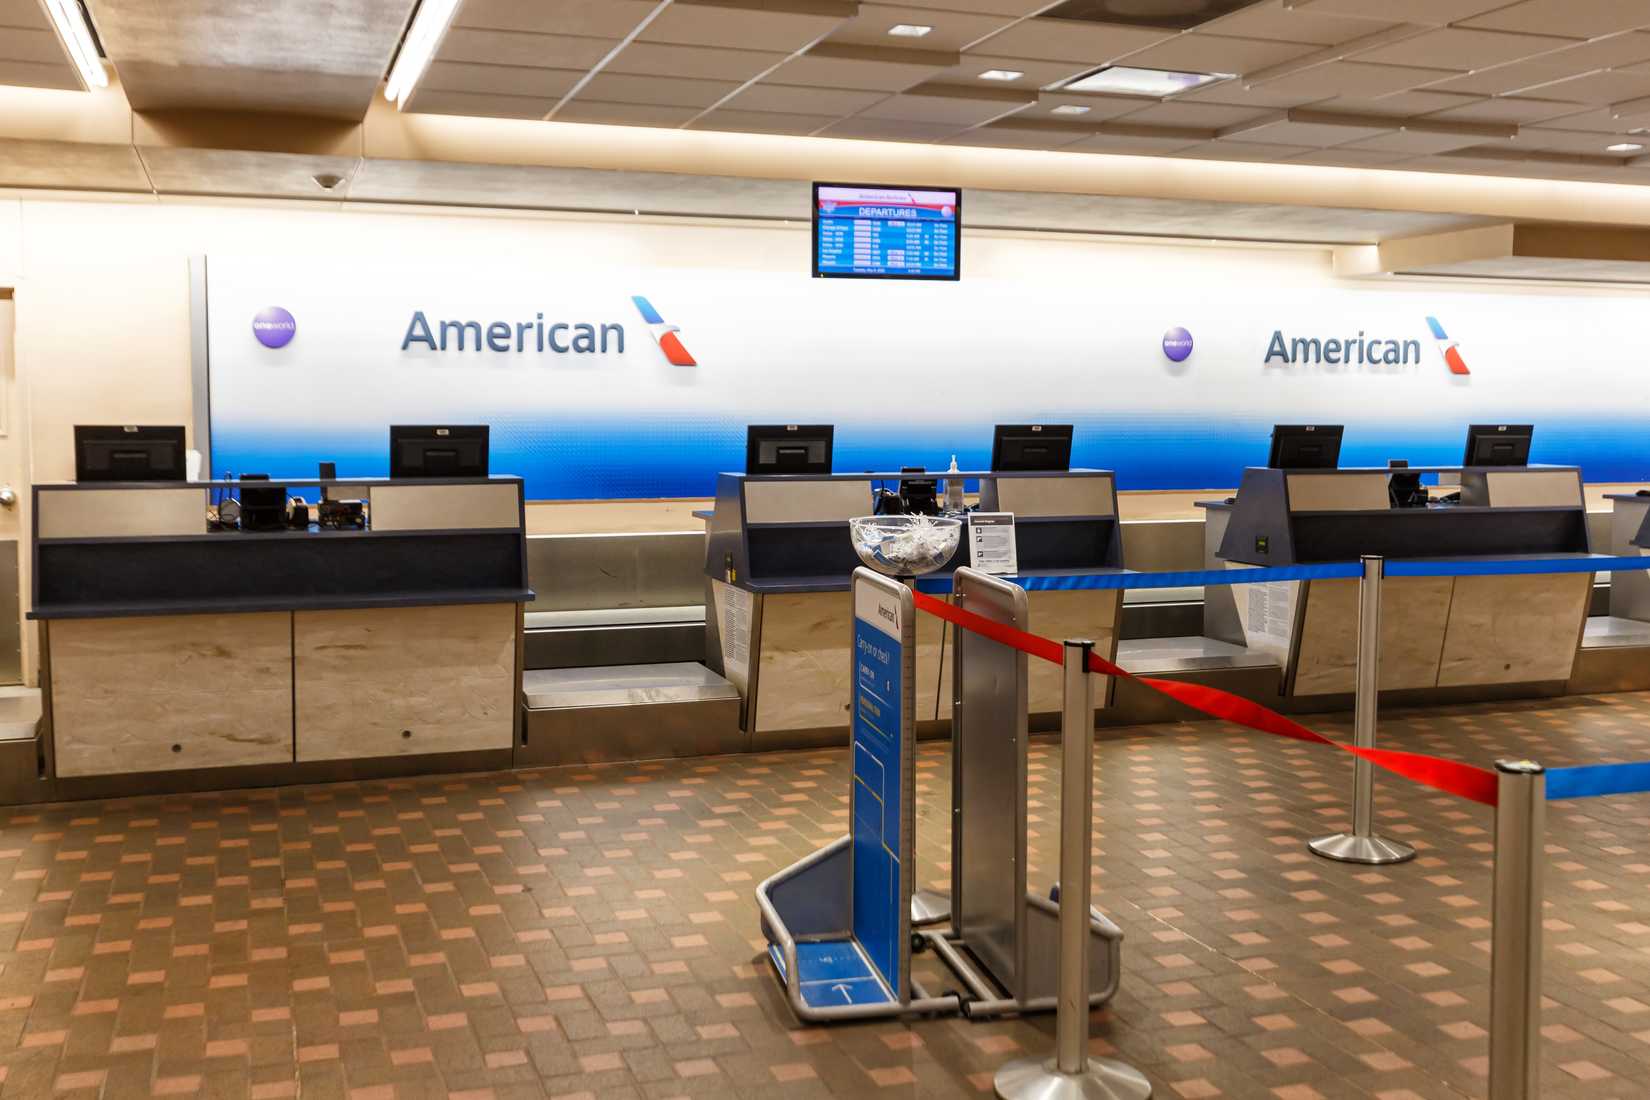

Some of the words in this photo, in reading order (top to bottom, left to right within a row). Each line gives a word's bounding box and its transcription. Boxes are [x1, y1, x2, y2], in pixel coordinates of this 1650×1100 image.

[858, 207, 917, 217] DEPARTURES
[401, 311, 625, 353] American
[1264, 330, 1420, 364] American
[878, 603, 895, 623] American
